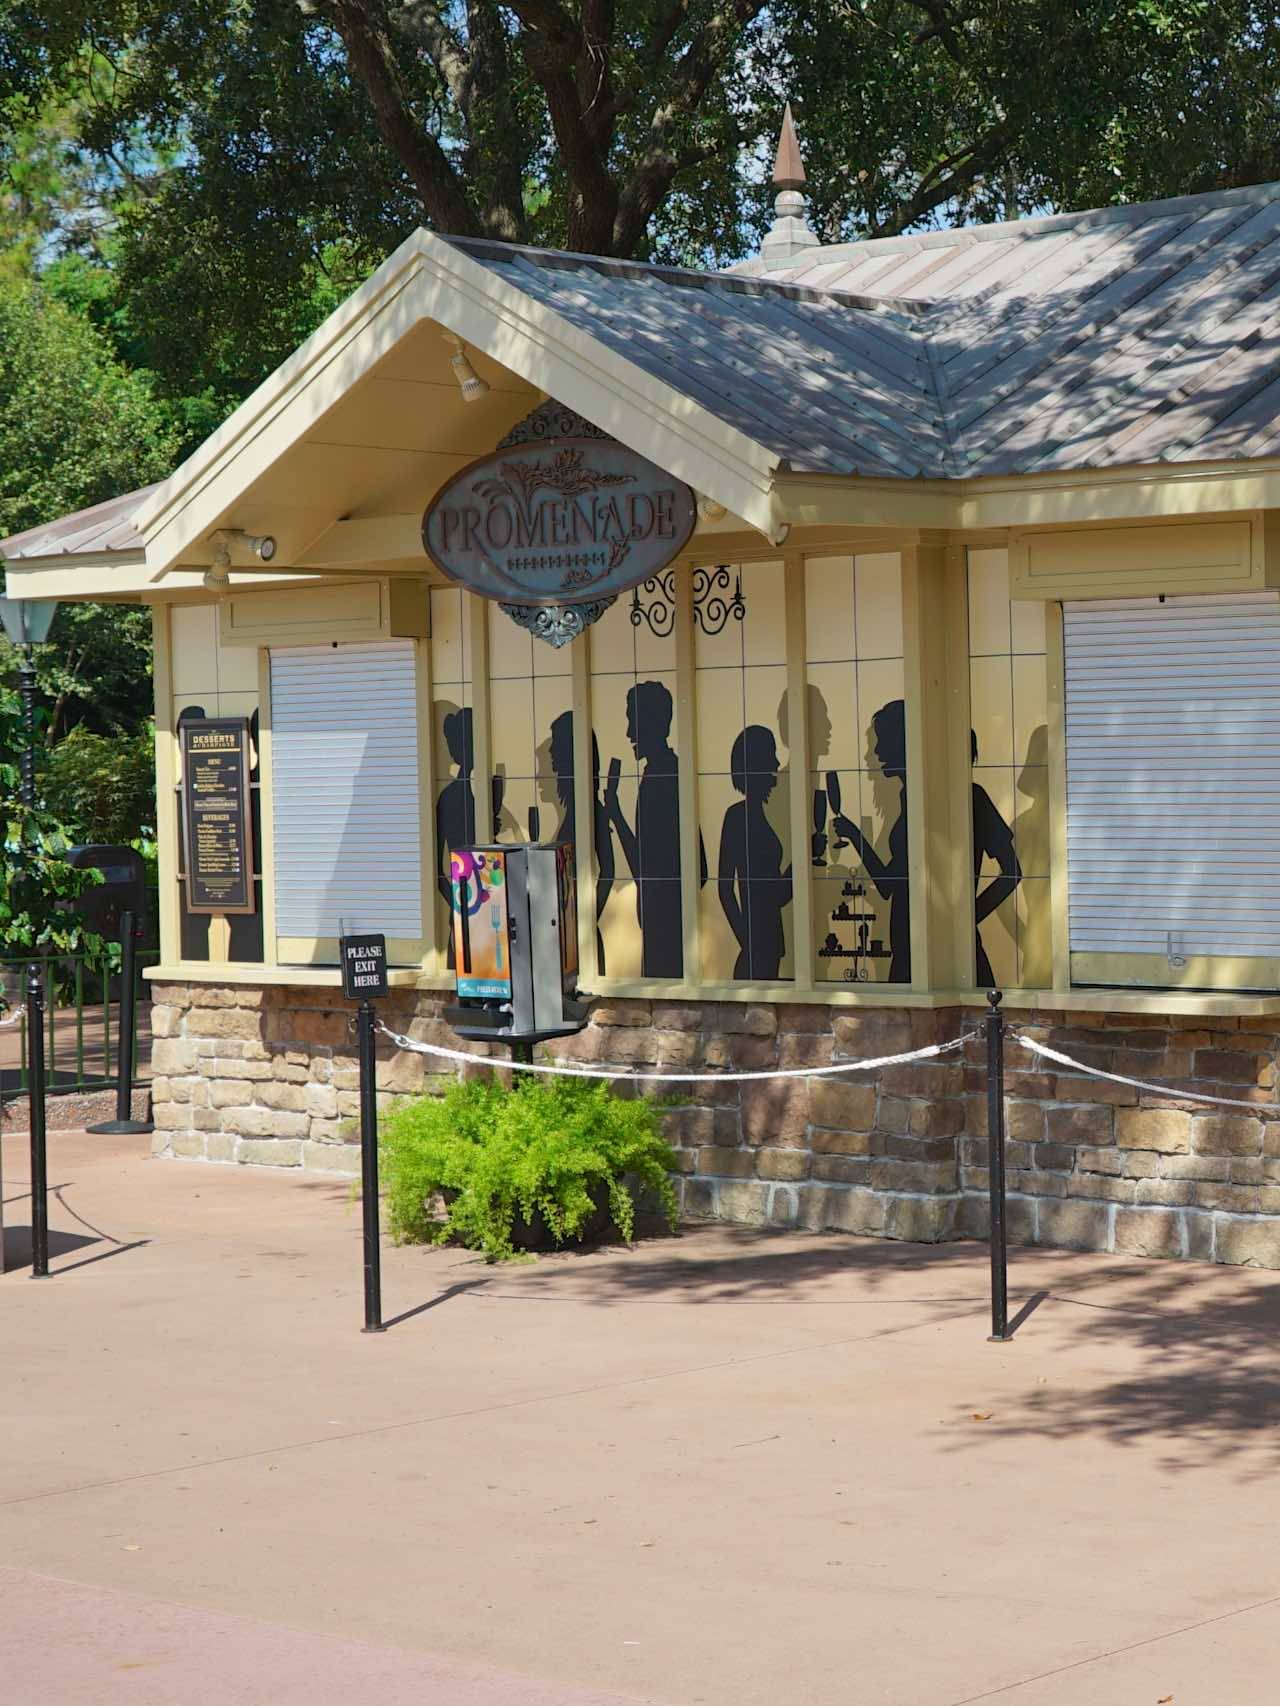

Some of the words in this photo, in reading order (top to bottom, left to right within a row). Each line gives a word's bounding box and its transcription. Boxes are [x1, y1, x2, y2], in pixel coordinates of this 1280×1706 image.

[437, 488, 677, 553] PROMENADE
[193, 734, 235, 744] DESSERTS
[347, 945, 382, 959] PLEASE
[355, 960, 377, 973] EXIT
[354, 974, 380, 987] HERE
